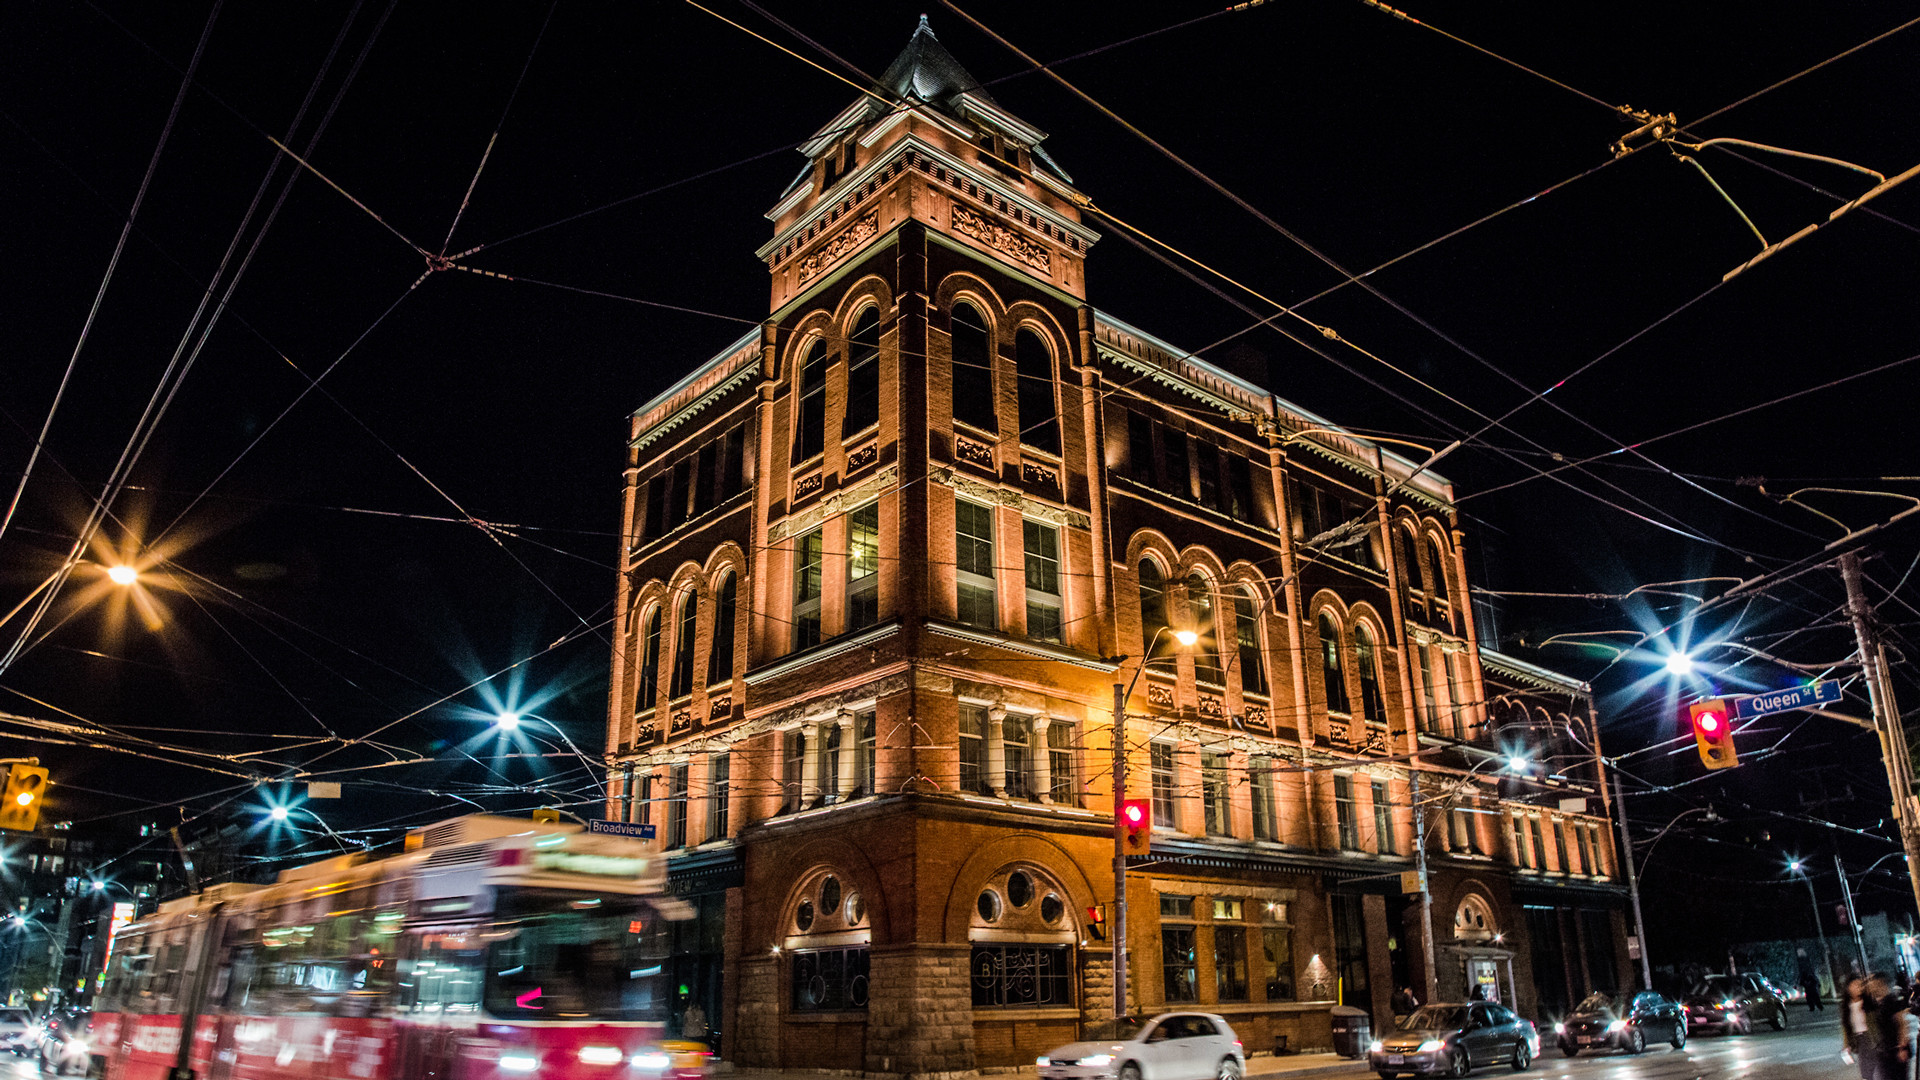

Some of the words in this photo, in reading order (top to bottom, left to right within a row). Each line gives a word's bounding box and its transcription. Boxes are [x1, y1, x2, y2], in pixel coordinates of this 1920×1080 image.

[1752, 693, 1800, 712] Queen
[1803, 688, 1811, 696] St
[1814, 684, 1824, 700] E
[593, 821, 643, 835] Broadview
[665, 879, 693, 895] DVIEW
